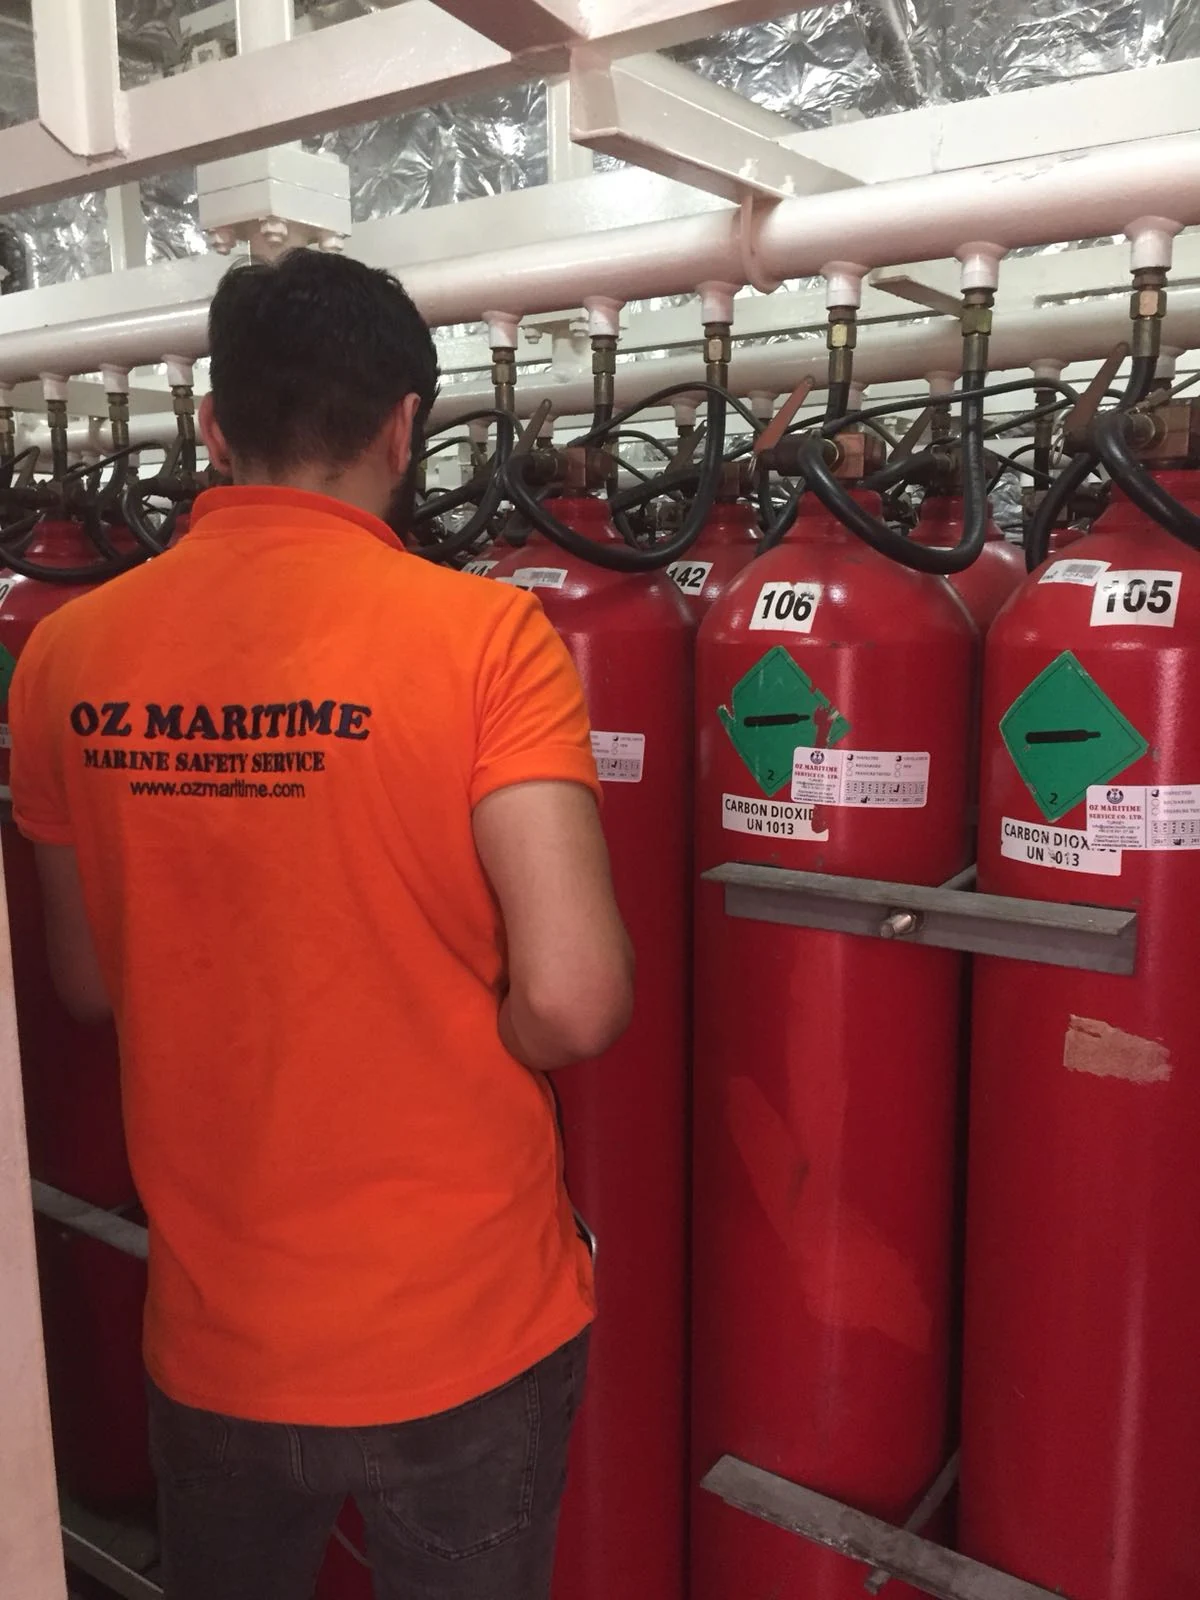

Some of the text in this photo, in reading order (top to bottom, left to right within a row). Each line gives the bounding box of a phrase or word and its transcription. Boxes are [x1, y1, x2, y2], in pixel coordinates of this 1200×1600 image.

[762, 590, 815, 621] 106
[1103, 579, 1173, 614] 105
[70, 699, 372, 740] OZ MARITIME
[84, 748, 325, 773] MARINE SAFETY SERVICE
[767, 769, 775, 781] 2
[130, 778, 306, 798] www.ozmaritime.com
[1049, 792, 1058, 805] 2
[725, 798, 813, 821] CARBON DIOXID
[1100, 804, 1142, 812] MARITIME
[747, 818, 794, 835] UN 1013
[1004, 823, 1050, 844] CARBON
[1027, 845, 1080, 867] UN 013
